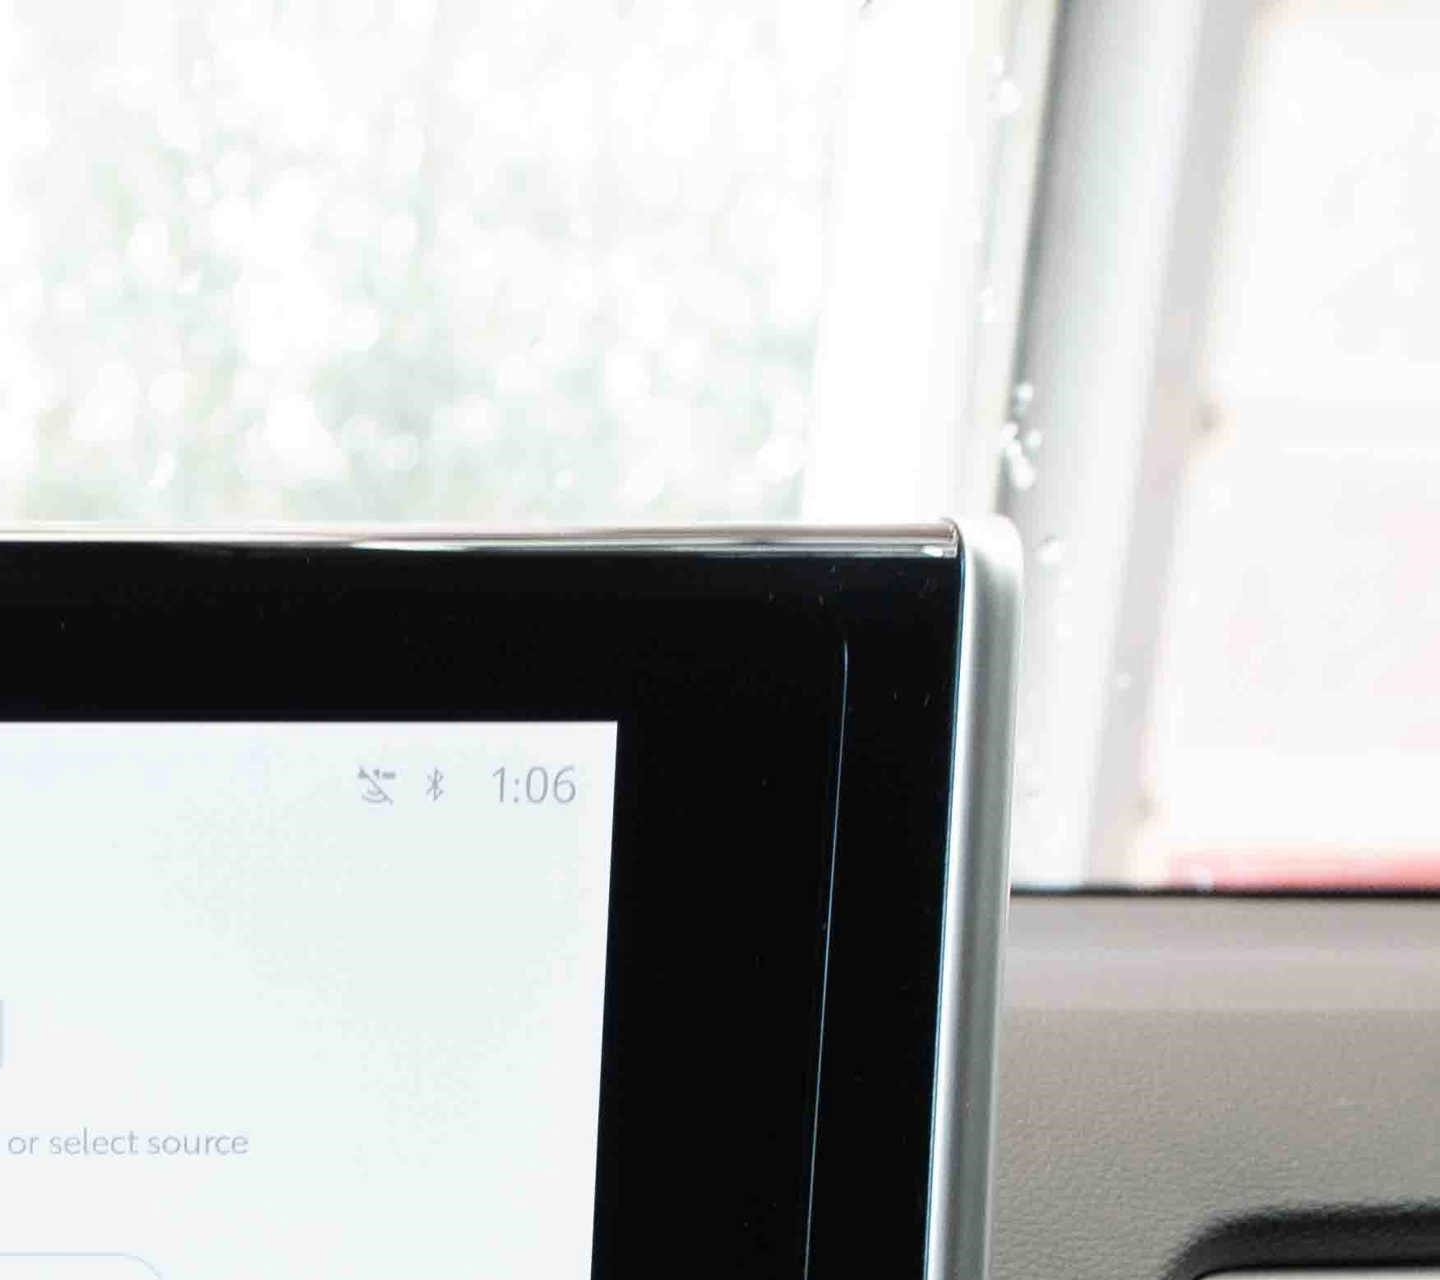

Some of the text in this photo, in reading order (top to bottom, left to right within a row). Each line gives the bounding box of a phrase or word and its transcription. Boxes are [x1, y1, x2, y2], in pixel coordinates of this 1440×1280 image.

[492, 766, 576, 803] 1:06
[8, 1135, 39, 1156] or
[49, 1128, 138, 1157] select
[148, 1134, 248, 1156] source
